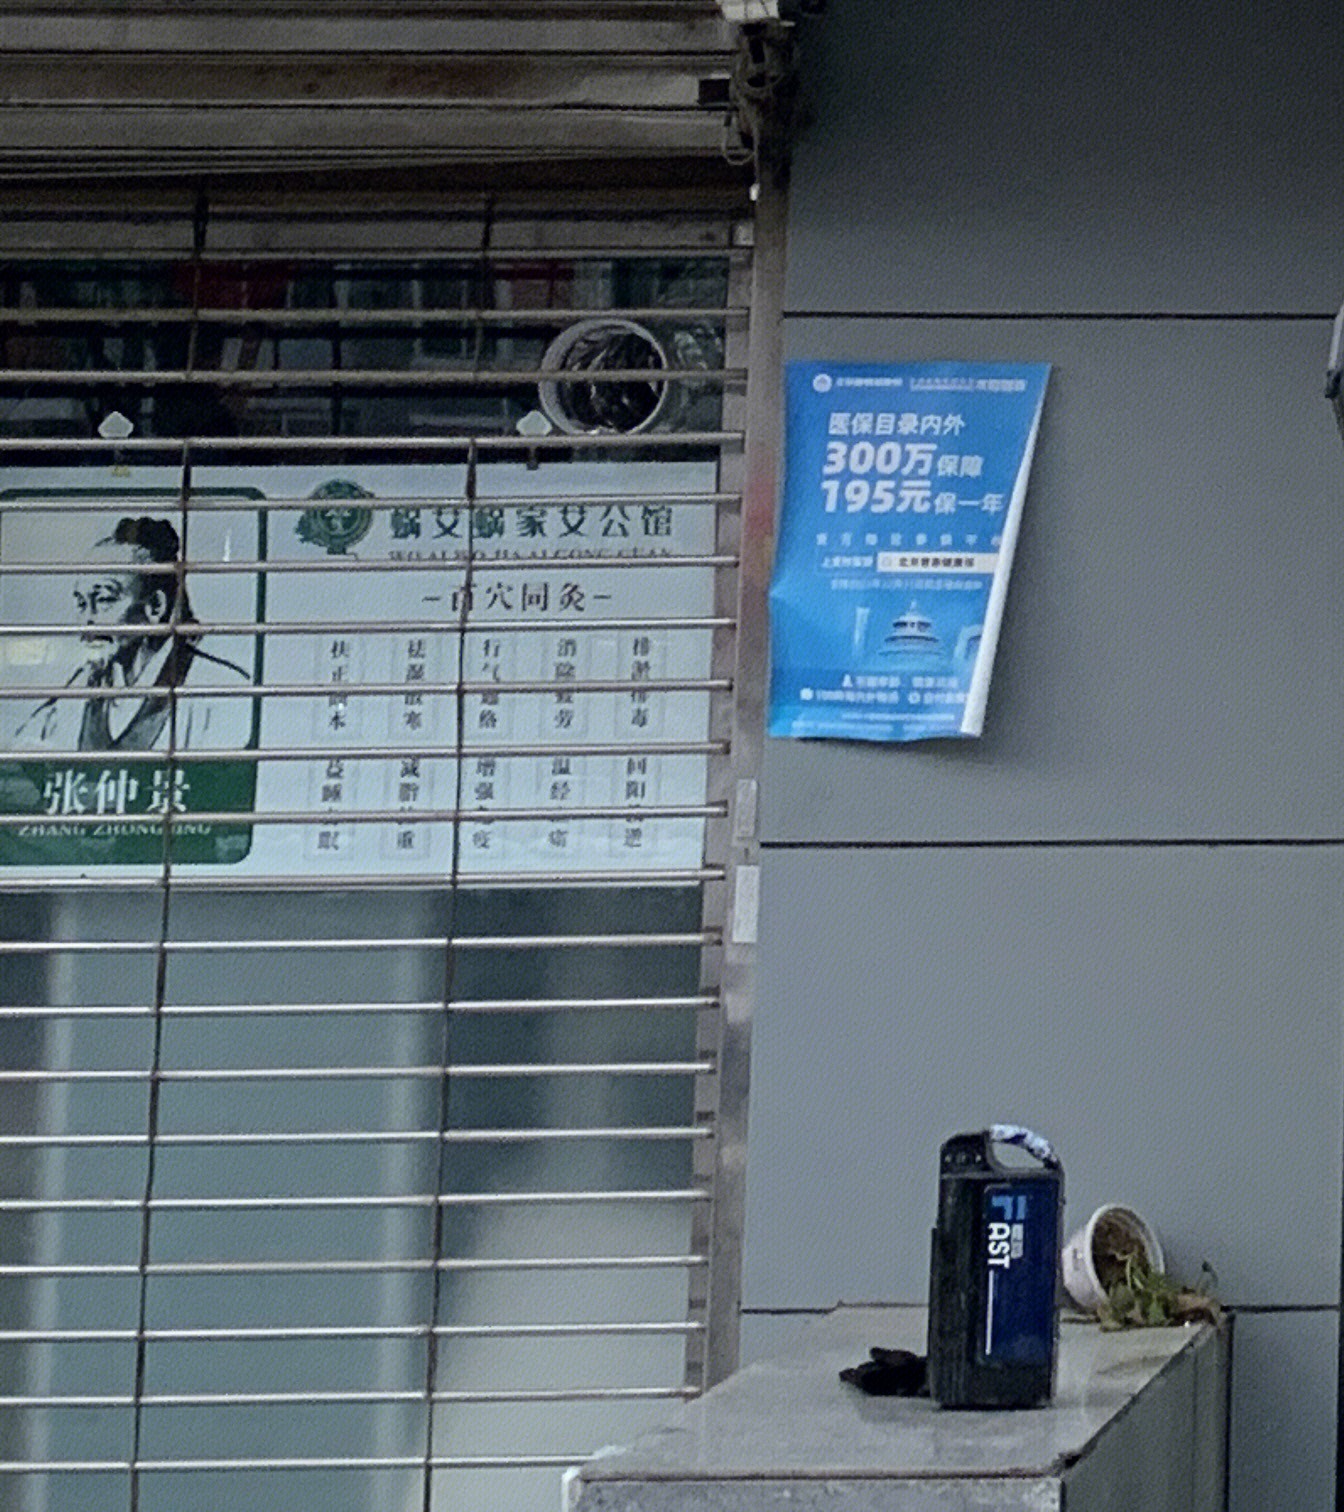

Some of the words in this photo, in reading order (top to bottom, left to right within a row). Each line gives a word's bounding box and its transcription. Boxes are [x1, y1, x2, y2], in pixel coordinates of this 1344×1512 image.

[828, 412, 965, 436] 医保目录内外
[43, 769, 190, 814] 张仲景
